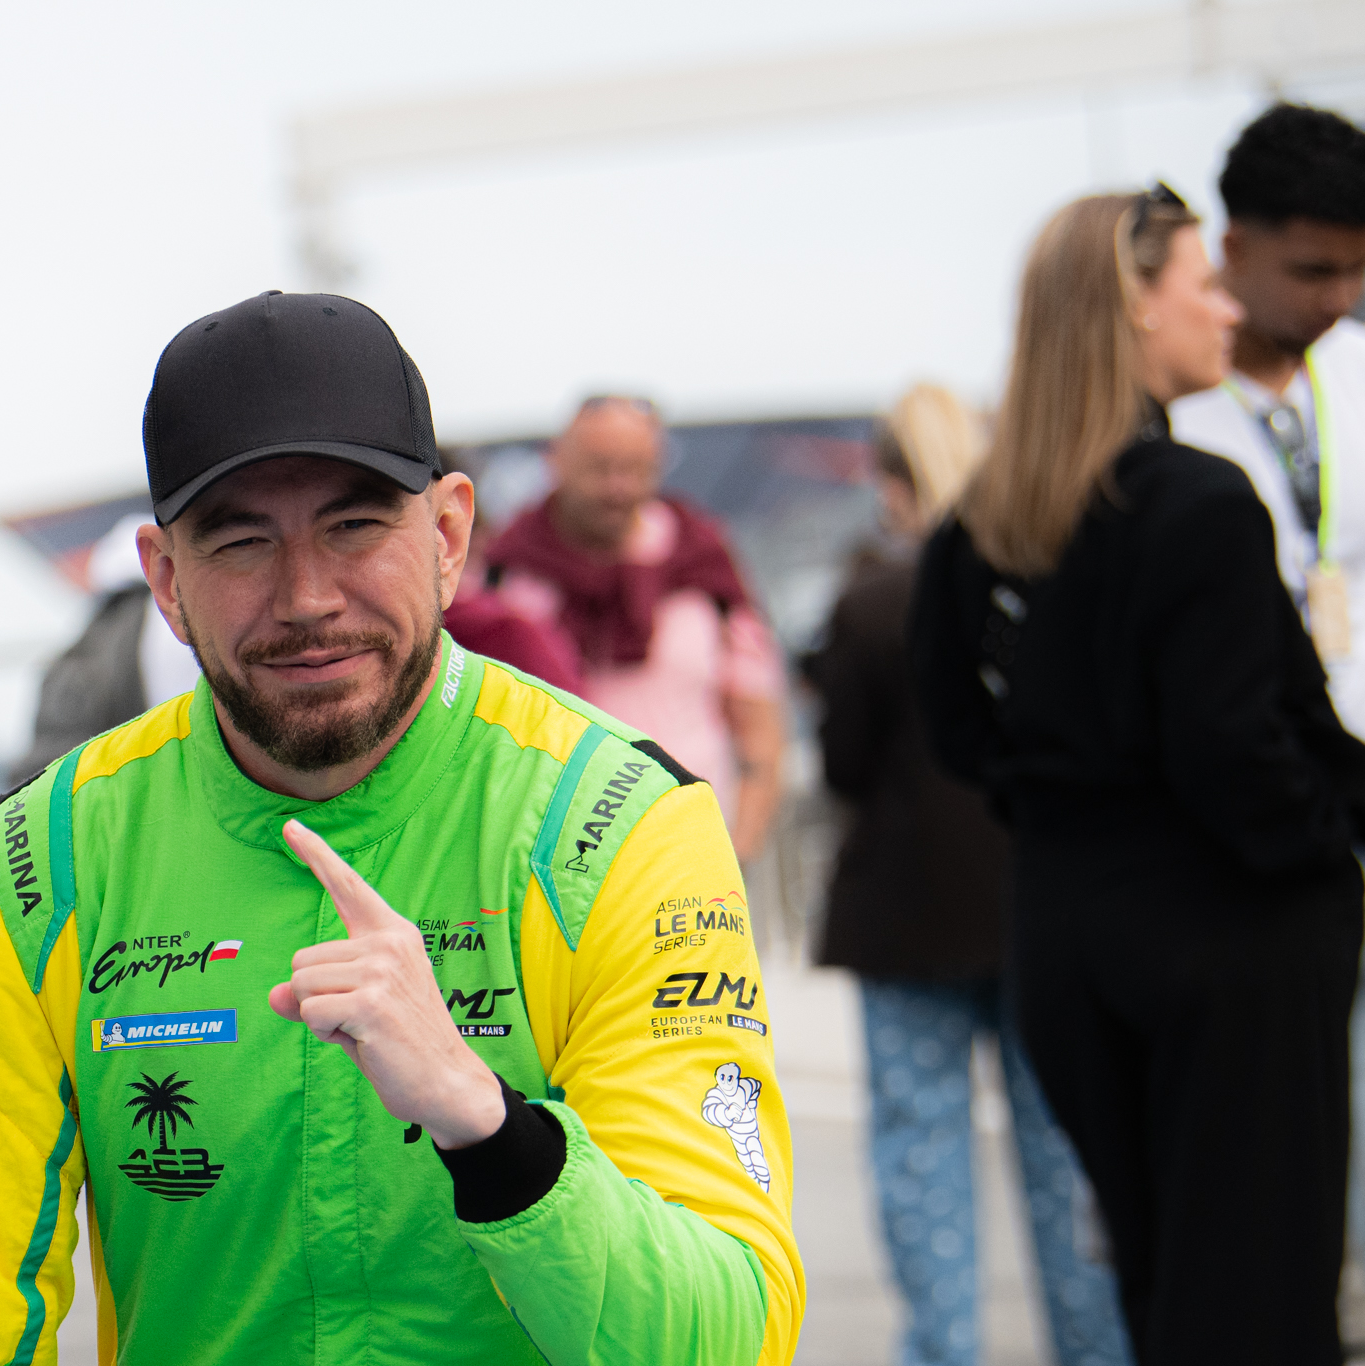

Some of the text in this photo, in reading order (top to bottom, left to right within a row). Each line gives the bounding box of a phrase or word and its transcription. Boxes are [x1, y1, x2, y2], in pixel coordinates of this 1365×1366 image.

[565, 761, 652, 873] MARINA
[4, 790, 42, 918] MARINA
[656, 896, 702, 915] ASIAN
[655, 910, 744, 938] LE MANS
[133, 935, 182, 950] NTER
[424, 932, 486, 952] E MAN
[654, 934, 706, 955] SERIES
[127, 1020, 223, 1038] MICHELIN
[462, 1026, 504, 1036] LE MANS
[651, 1015, 764, 1034] EUROPEAN LE MANS
[653, 1026, 702, 1039] SERIES
